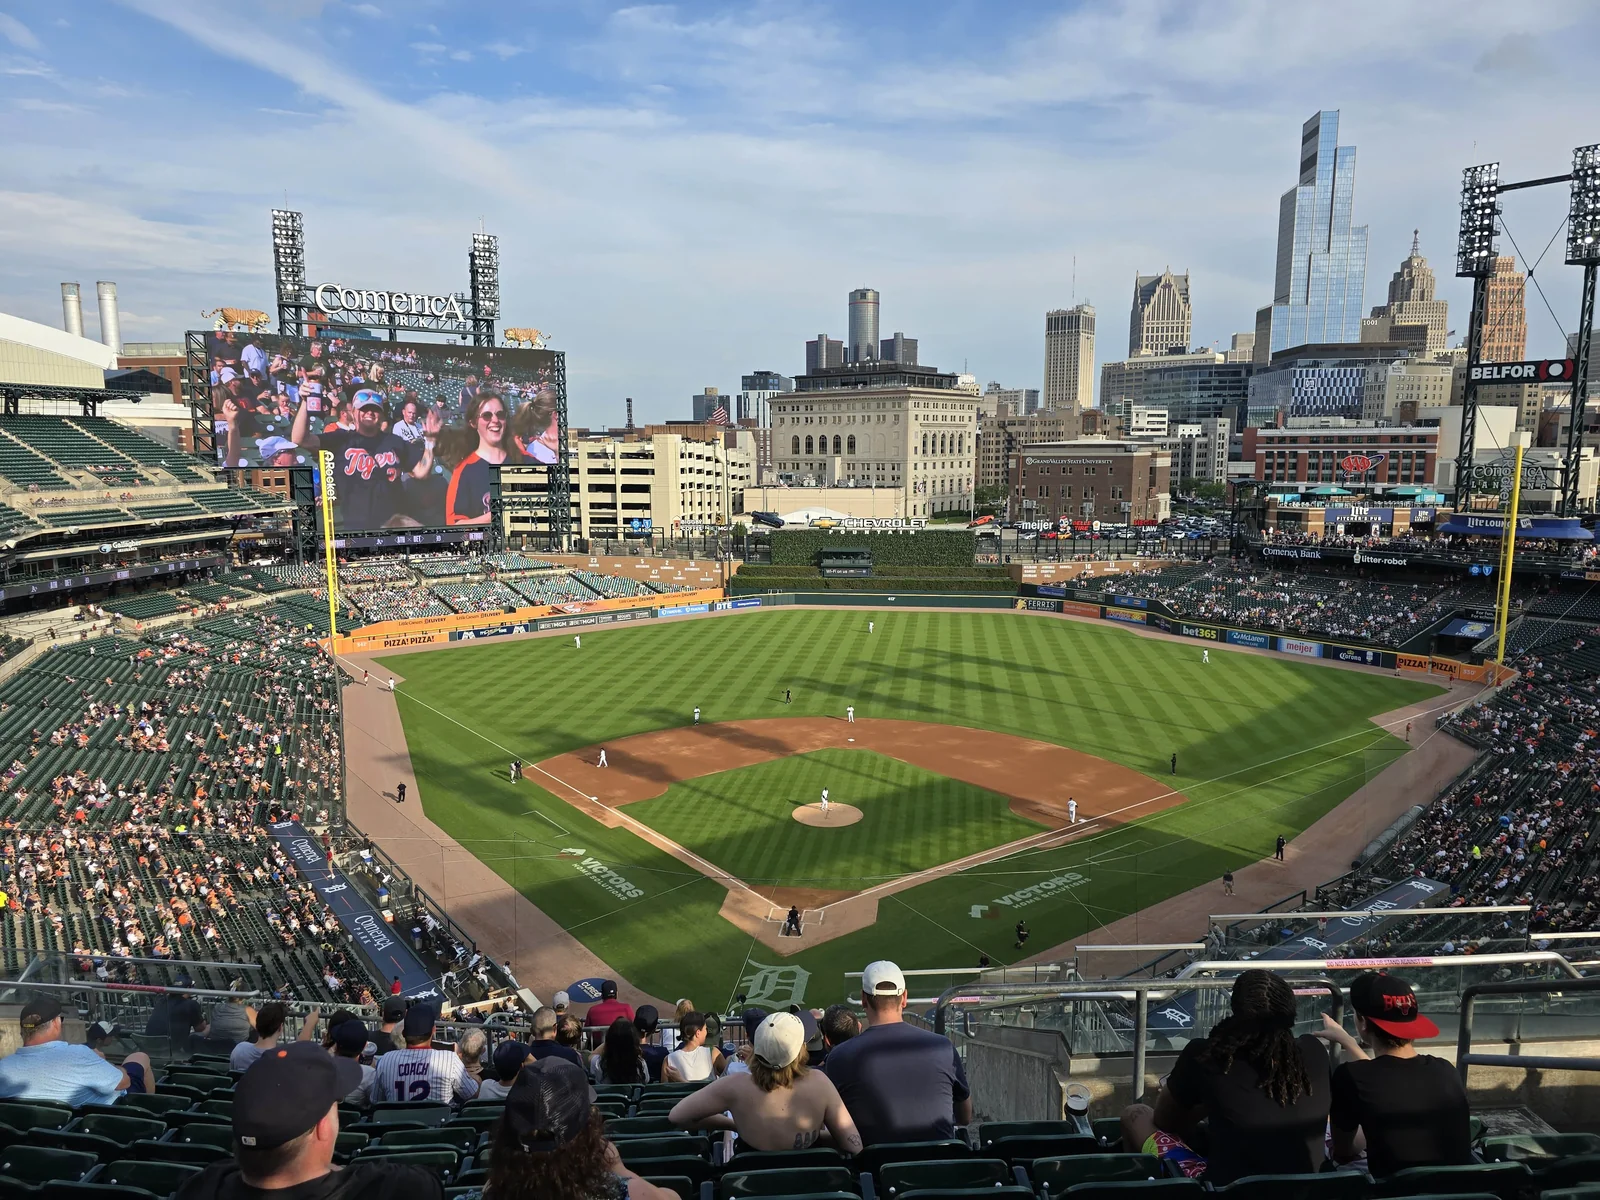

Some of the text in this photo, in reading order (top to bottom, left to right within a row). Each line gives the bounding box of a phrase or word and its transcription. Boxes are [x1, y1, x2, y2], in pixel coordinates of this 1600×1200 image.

[360, 312, 428, 328] PARK
[1471, 365, 1536, 380] BELFOR
[1343, 458, 1371, 471] AAA
[325, 462, 337, 501] Rocket
[1500, 460, 1515, 506] Rocket
[844, 518, 929, 528] CHEVROLET
[1022, 518, 1054, 532] meijer
[1300, 549, 1321, 559] Bank
[717, 602, 732, 610] DTE
[1028, 599, 1055, 608] FERRIS
[424, 617, 446, 625] DELIVERY
[1182, 625, 1217, 640] bet365
[1239, 633, 1265, 644] McLaren
[384, 635, 435, 648] PIZZA! PIZZA!
[1286, 641, 1313, 653] meijer
[1339, 651, 1362, 662] Corona
[1398, 657, 1457, 674] PIZZA! PIZZA!
[581, 857, 644, 898] VICTORS
[589, 875, 628, 901] SOLUTIONS
[992, 872, 1083, 906] VICTORS
[1012, 877, 1092, 909] HOME SOLUTIONS
[353, 926, 372, 945] PARK
[398, 1062, 430, 1077] COACH
[394, 1080, 431, 1102] 12
